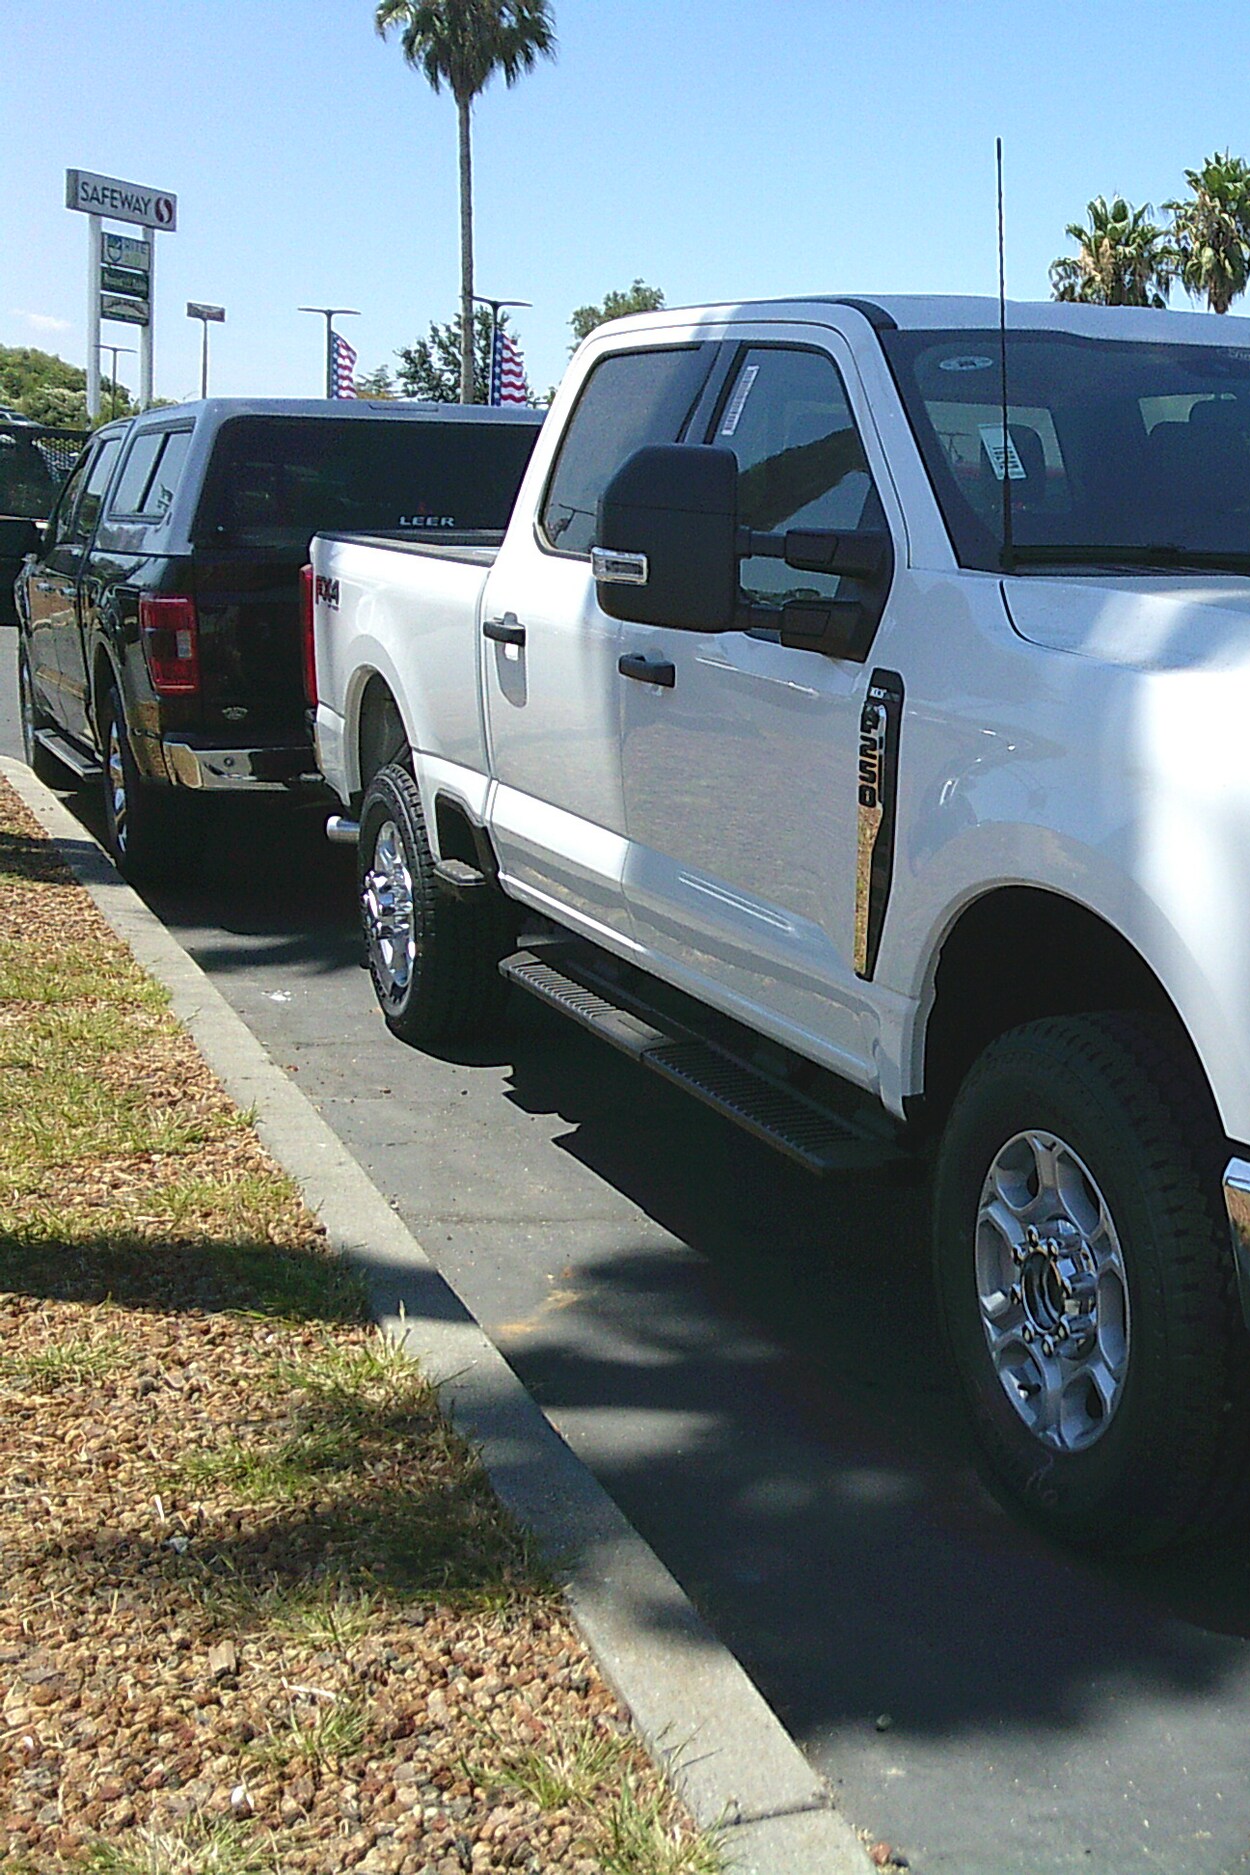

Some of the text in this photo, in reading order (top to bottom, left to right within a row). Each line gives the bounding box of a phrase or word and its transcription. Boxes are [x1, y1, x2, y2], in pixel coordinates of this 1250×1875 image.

[80, 181, 151, 215] SAFEWAY
[400, 516, 455, 527] LEER
[316, 574, 340, 605] FX4
